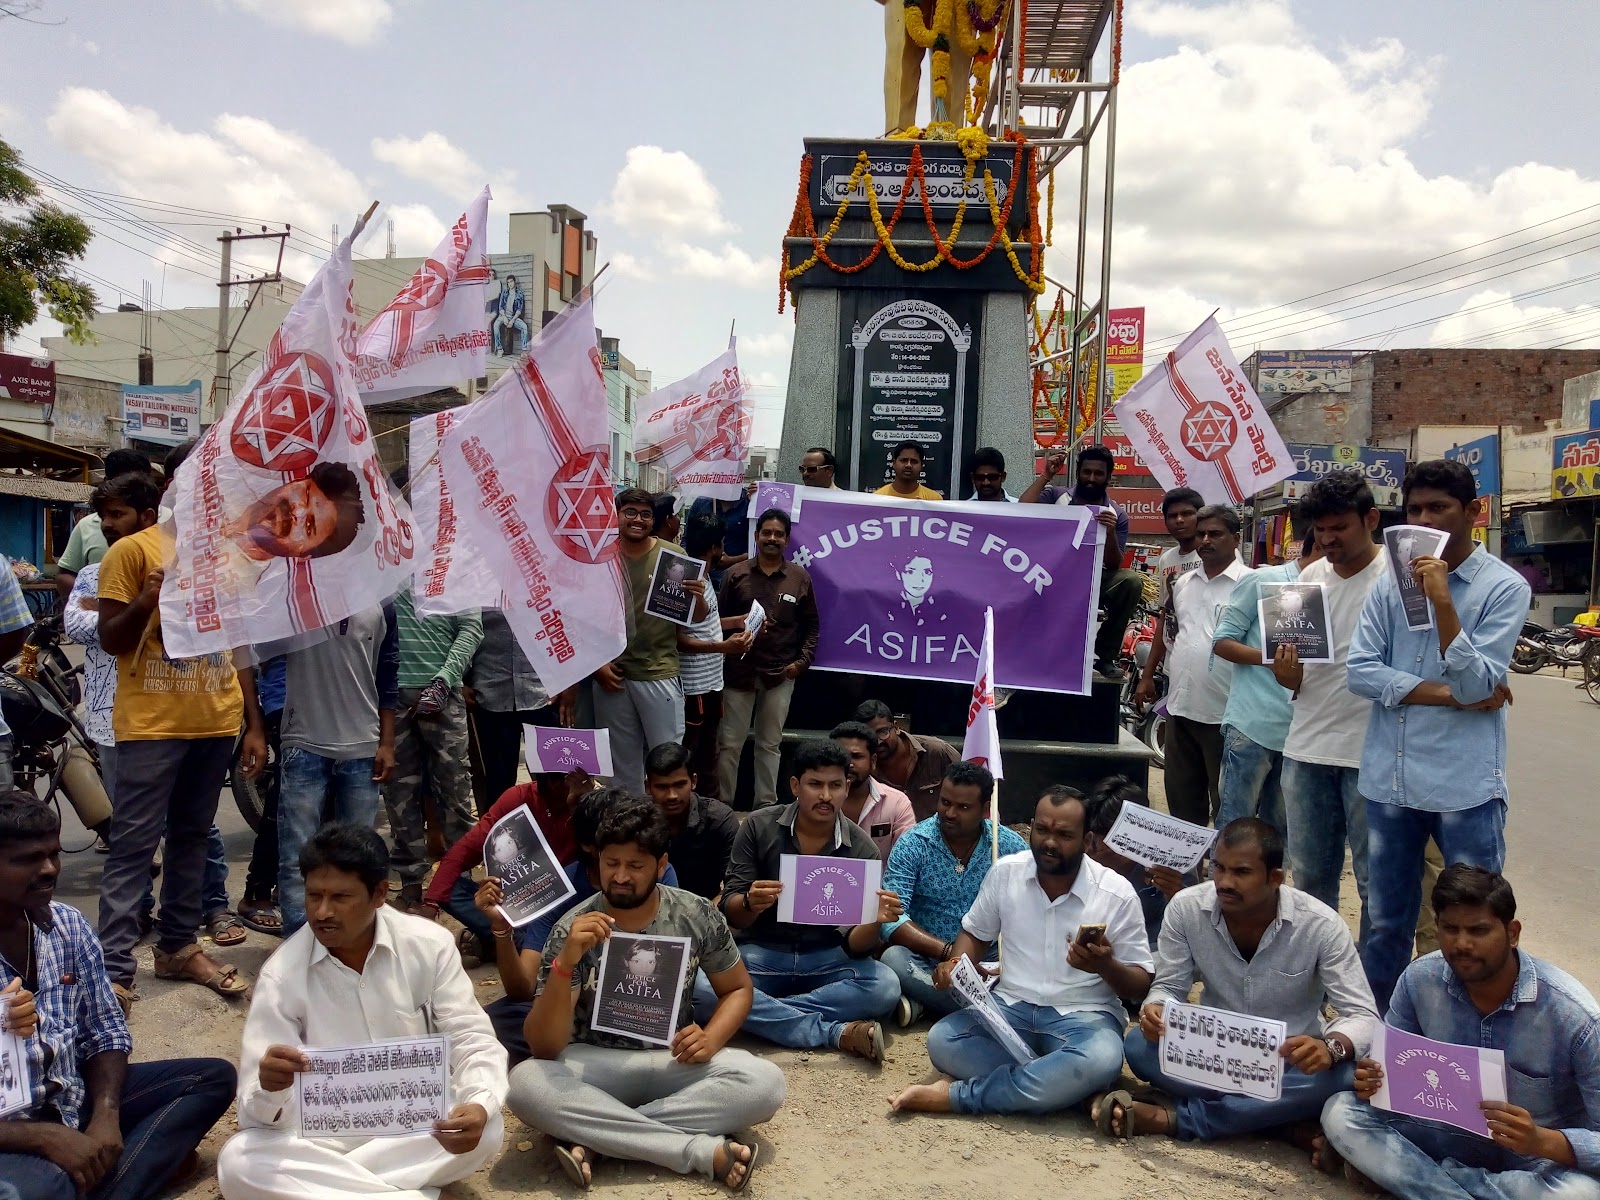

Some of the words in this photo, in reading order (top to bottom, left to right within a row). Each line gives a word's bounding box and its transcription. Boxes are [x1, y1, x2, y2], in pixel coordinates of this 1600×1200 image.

[11, 376, 28, 384] AXIS
[31, 379, 51, 387] BANK
[125, 399, 144, 408] VASAVI
[145, 401, 170, 411] TAILORING
[171, 404, 198, 415] MATERIALS
[1449, 447, 1481, 465] vivo
[1119, 500, 1155, 513] airtel
[791, 516, 974, 569] #JUSTICE
[980, 533, 1054, 596] FOR
[659, 583, 686, 599] ASIFA
[1275, 620, 1315, 629] ASIFA
[844, 623, 981, 664] ASIFA
[576, 738, 590, 751] FOR
[500, 853, 526, 872] JUSTICE
[509, 862, 524, 873] FOR
[501, 861, 541, 889] ASIFA
[803, 866, 844, 886] #JUSTICE
[843, 872, 858, 887] FOR
[811, 904, 843, 916] ASIFA
[625, 974, 656, 983] JUSTICE
[614, 981, 662, 999] ASIFA
[1395, 1049, 1448, 1066] #JUSTICE
[1448, 1061, 1471, 1082] FOR
[1413, 1091, 1458, 1112] ASIFA
